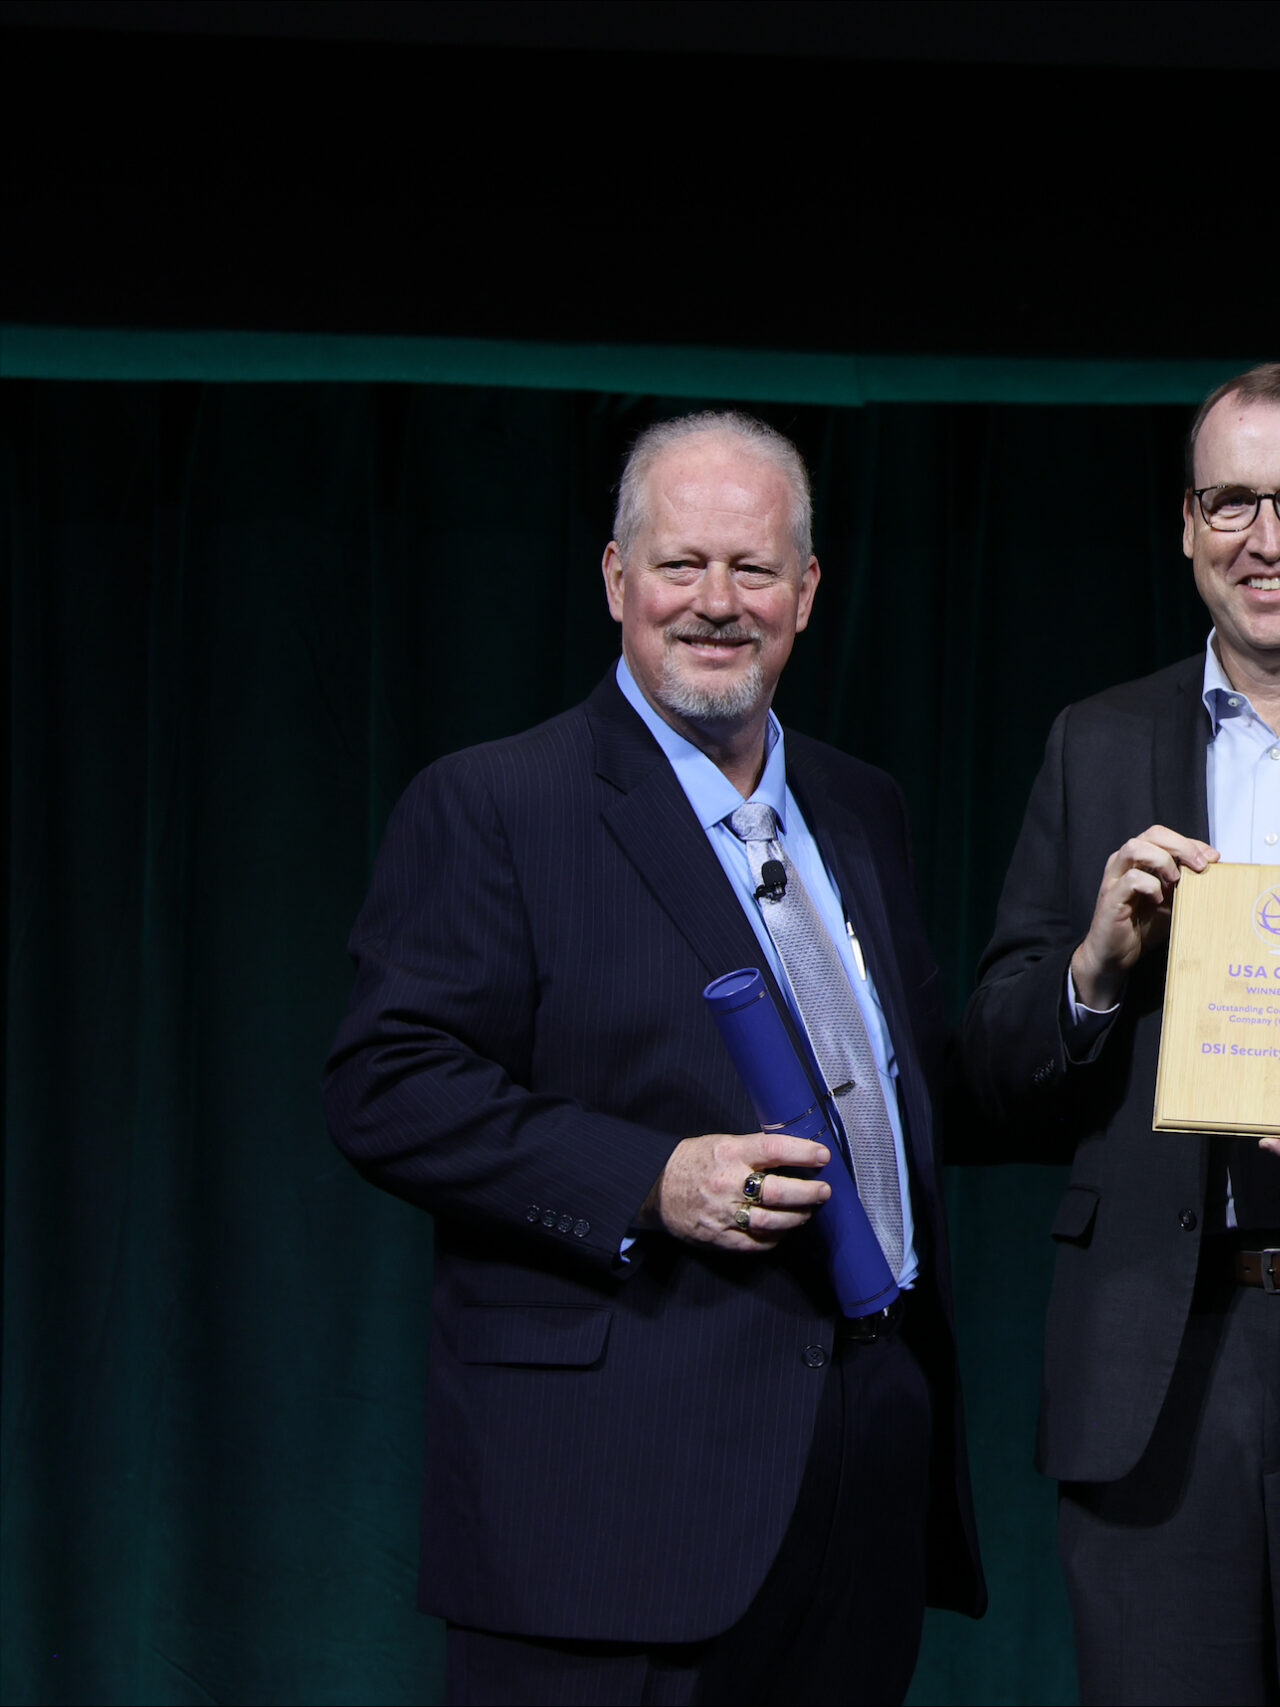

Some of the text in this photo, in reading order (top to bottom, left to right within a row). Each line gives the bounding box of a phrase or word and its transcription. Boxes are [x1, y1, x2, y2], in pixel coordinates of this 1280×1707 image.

[1228, 964, 1268, 979] USA
[1208, 1003, 1264, 1015] Outstanding
[1229, 1015, 1272, 1026] Company
[1201, 1042, 1226, 1055] DSI
